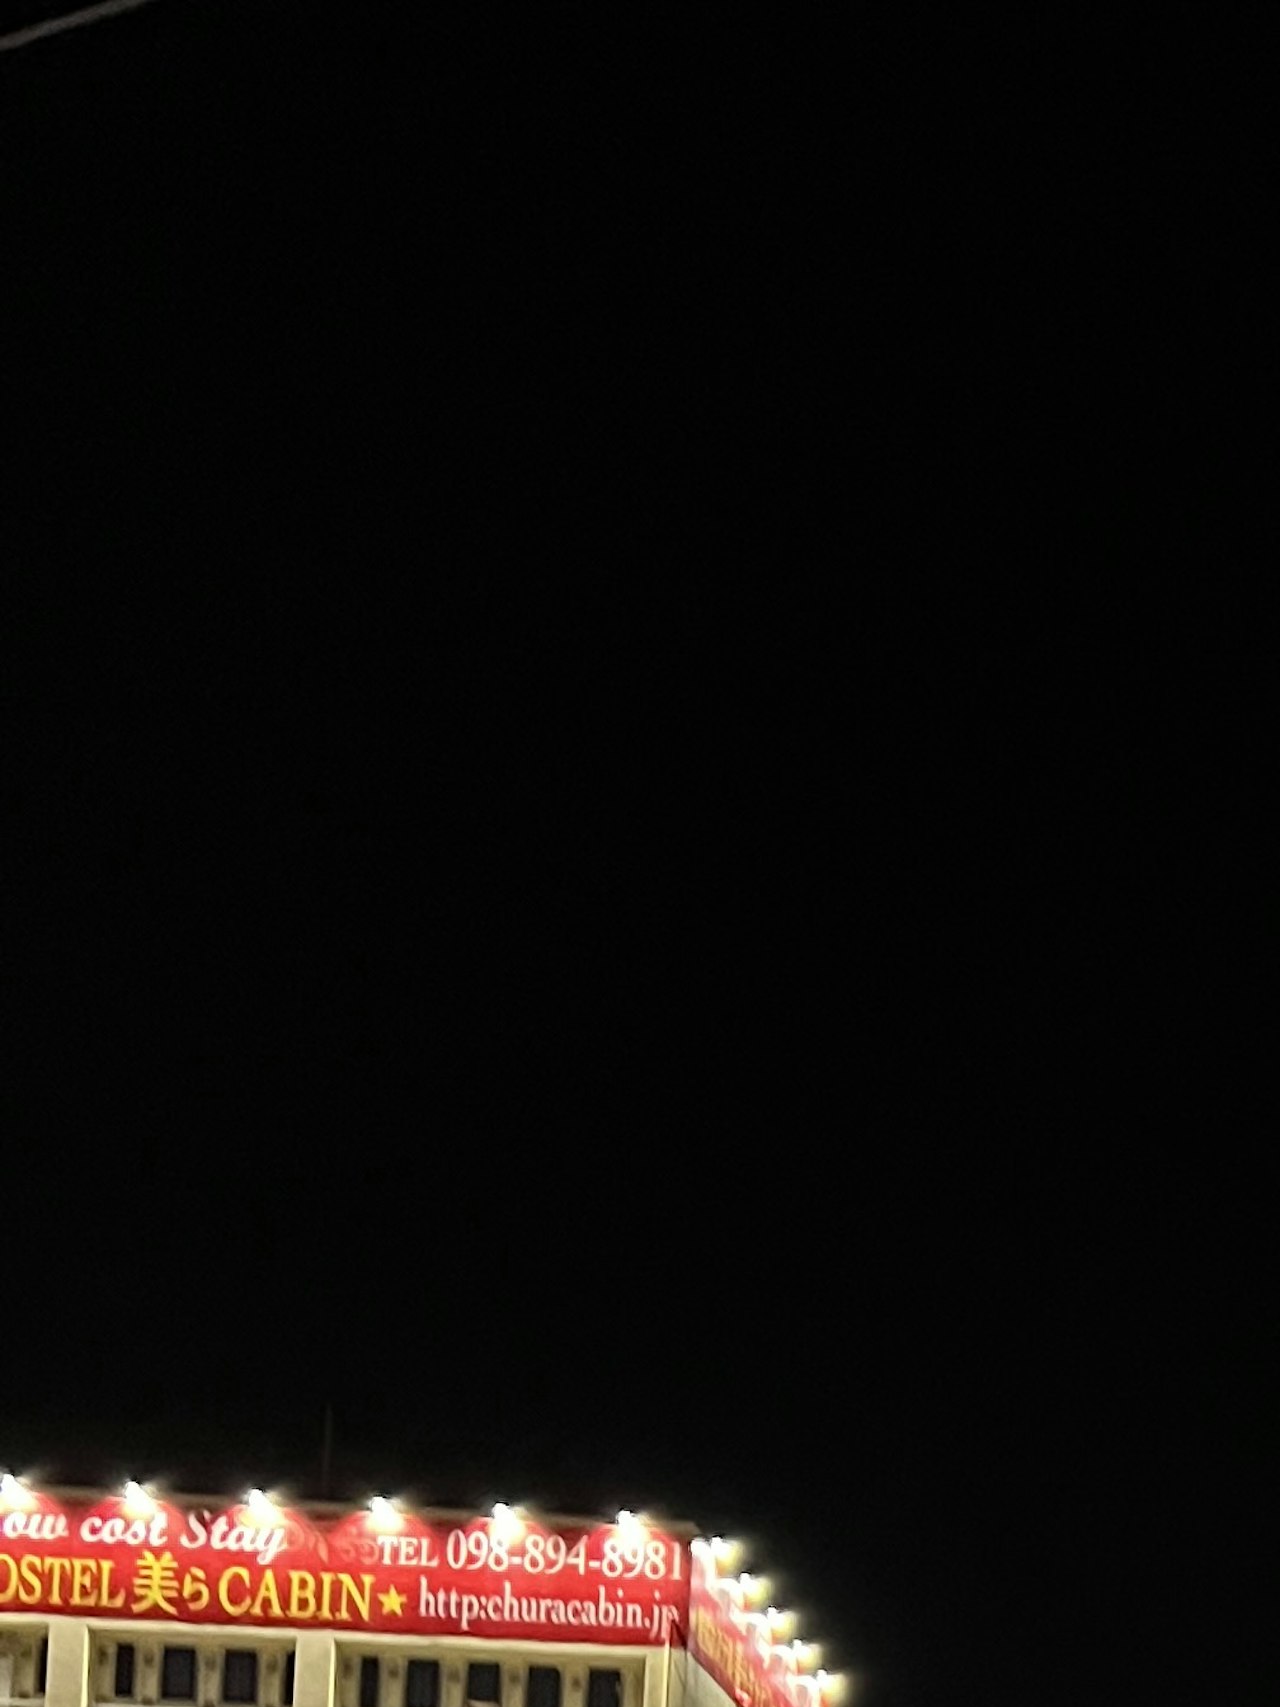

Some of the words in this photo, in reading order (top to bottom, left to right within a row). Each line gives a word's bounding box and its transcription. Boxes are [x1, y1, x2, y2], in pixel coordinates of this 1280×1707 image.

[80, 1510, 169, 1546] cost
[181, 1510, 288, 1566] Stay
[377, 1535, 439, 1568] TEL
[446, 1529, 685, 1581] 098-894-8981
[131, 1551, 210, 1616] 美ら
[218, 1566, 376, 1622] CABIN
